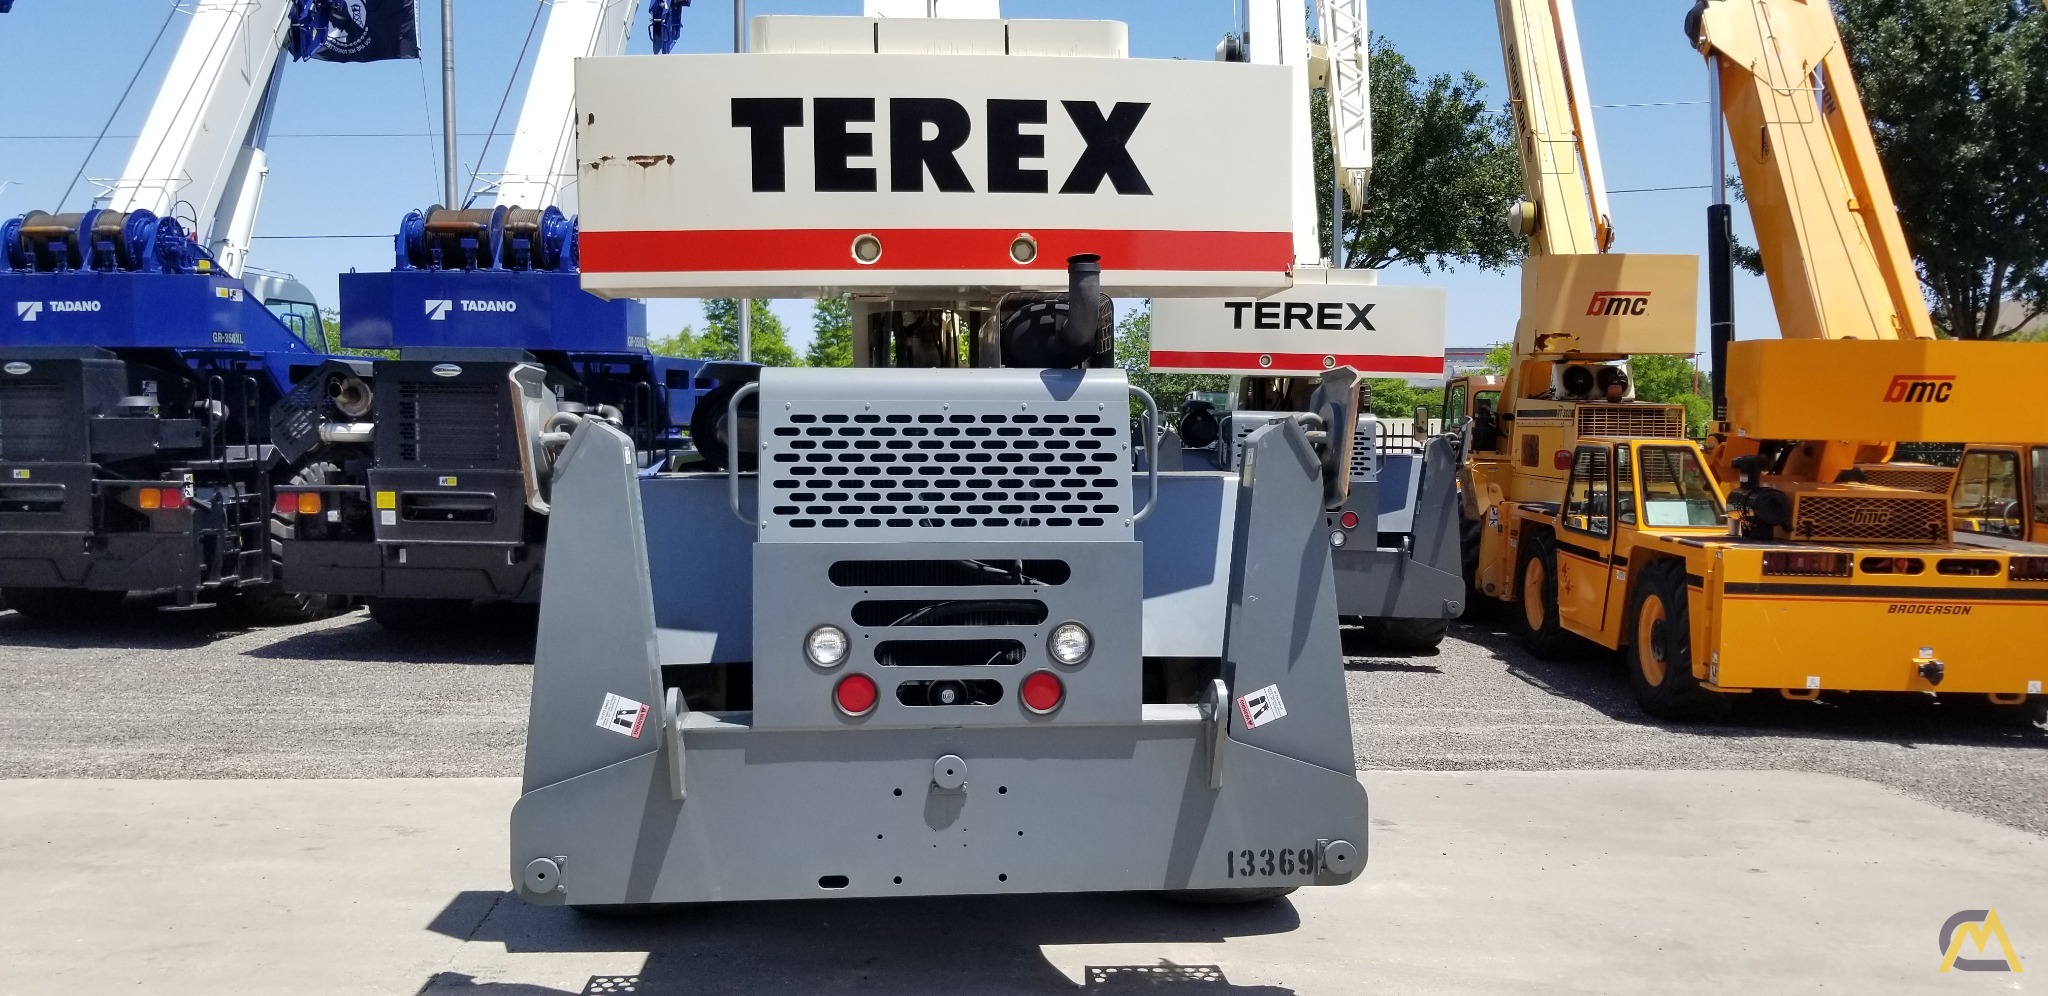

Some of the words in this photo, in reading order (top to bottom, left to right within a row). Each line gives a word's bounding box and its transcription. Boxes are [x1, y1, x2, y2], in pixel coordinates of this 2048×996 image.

[730, 97, 1154, 196] TEREX
[50, 300, 102, 312] TADANO
[460, 300, 517, 313] TADANO
[1224, 301, 1377, 331] TEREX
[1887, 604, 1972, 616] BRODERSON
[1227, 848, 1314, 879] 13369
